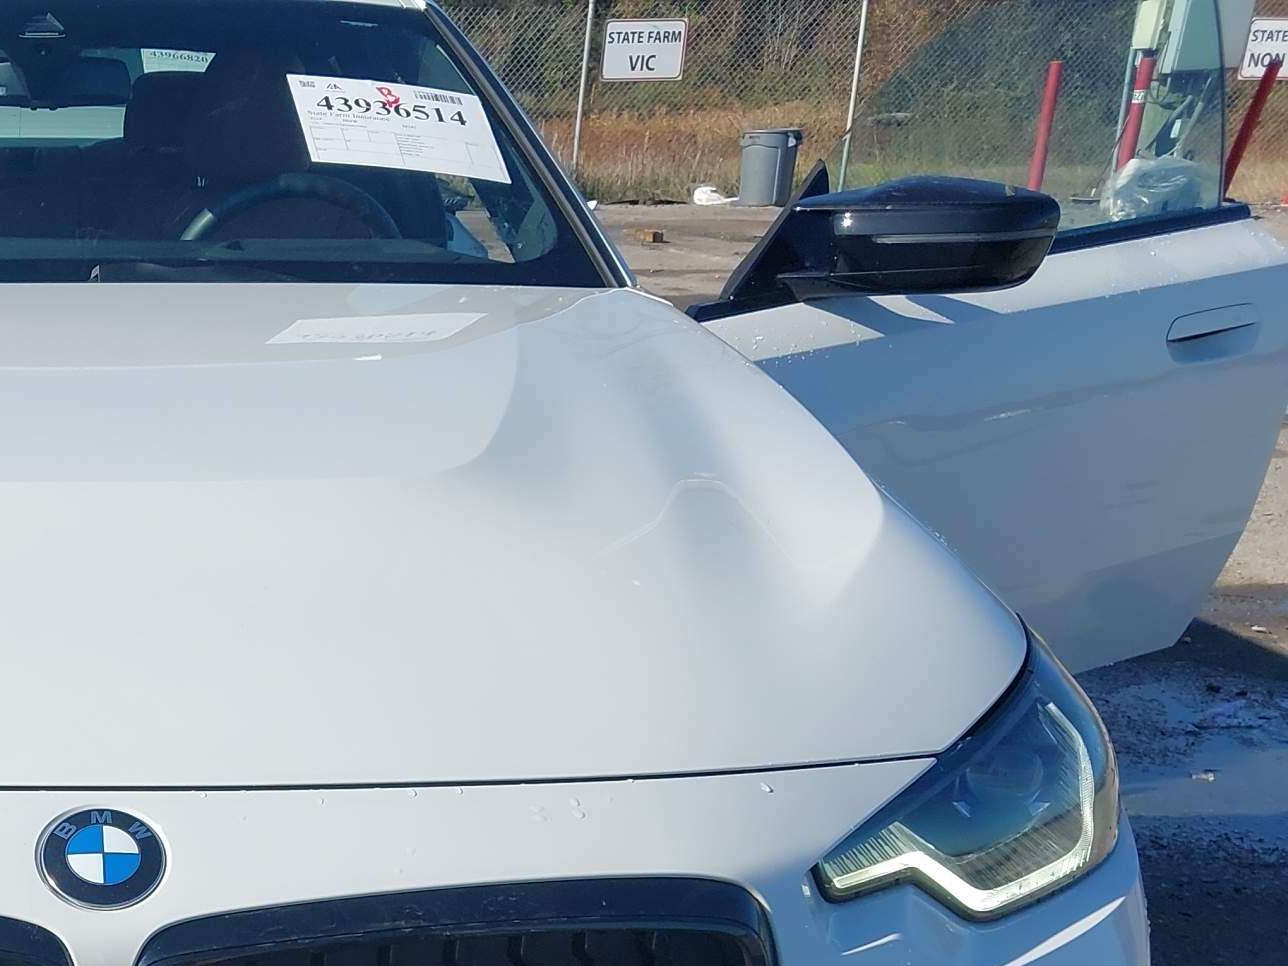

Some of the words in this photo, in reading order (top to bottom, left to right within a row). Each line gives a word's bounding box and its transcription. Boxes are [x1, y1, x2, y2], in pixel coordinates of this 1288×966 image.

[607, 31, 645, 44] STATE
[647, 30, 682, 44] FARM
[628, 54, 657, 72] VIC
[316, 95, 468, 127] 43936514
[53, 810, 153, 840] BMW
